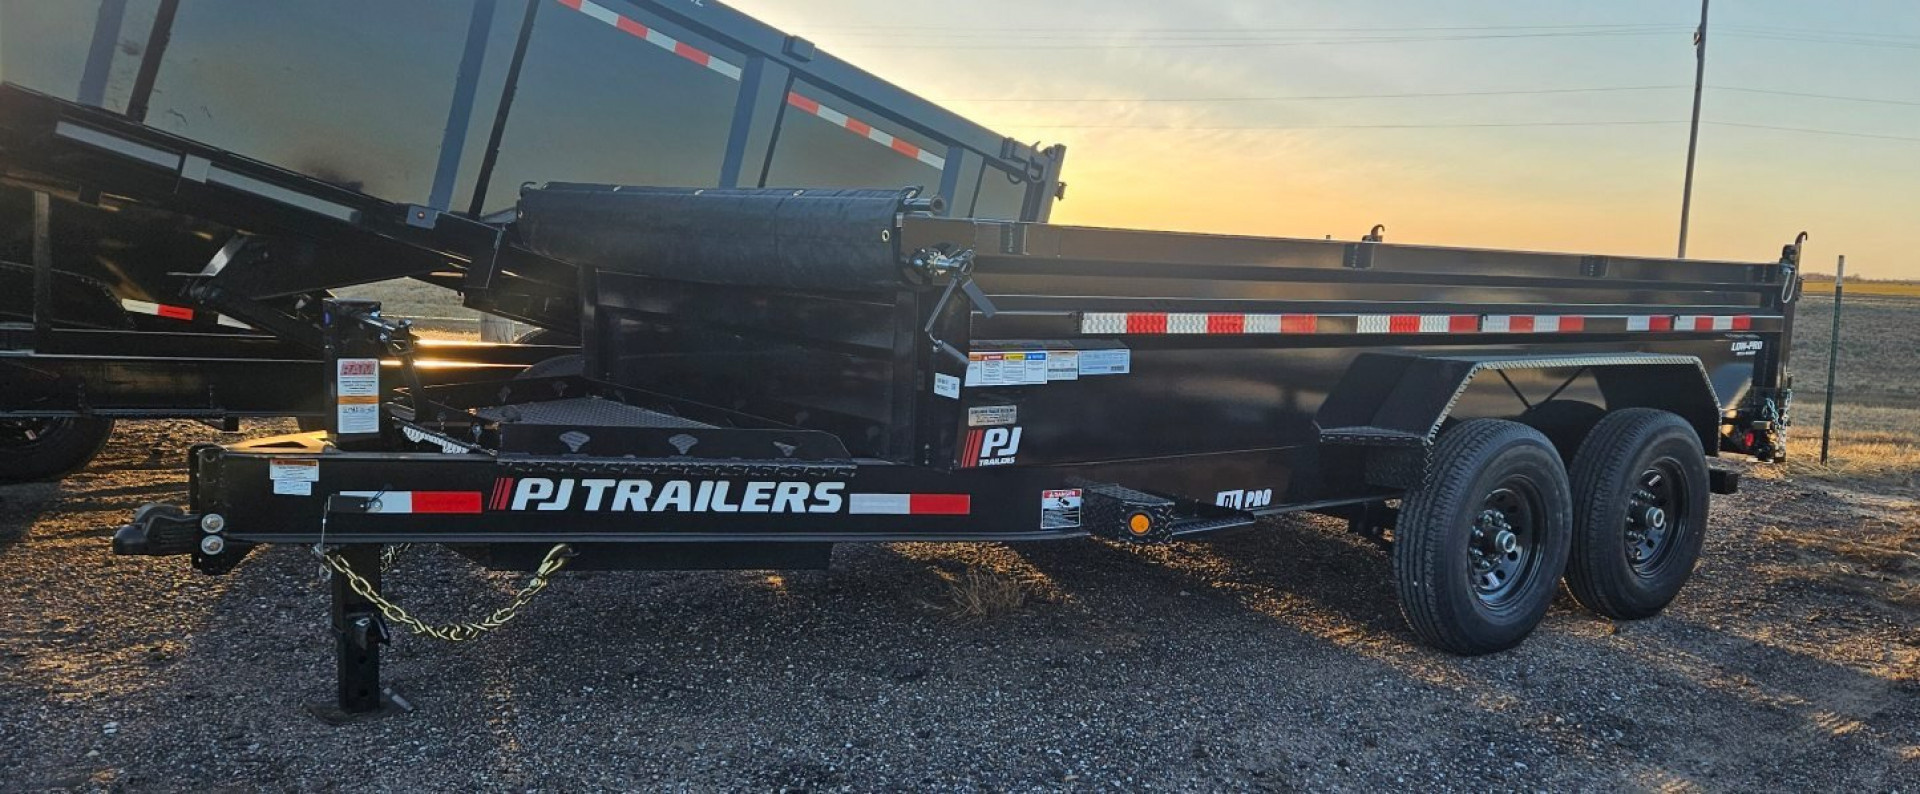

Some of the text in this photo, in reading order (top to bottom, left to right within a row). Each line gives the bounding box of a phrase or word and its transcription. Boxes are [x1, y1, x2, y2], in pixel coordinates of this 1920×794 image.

[1731, 340, 1763, 351] LOW-PRO
[340, 361, 376, 376] RAM
[980, 426, 1023, 458] PJ
[978, 456, 1016, 467] TRAILERS
[511, 478, 846, 513] PJ TRAILERS
[1244, 488, 1273, 508] PRO
